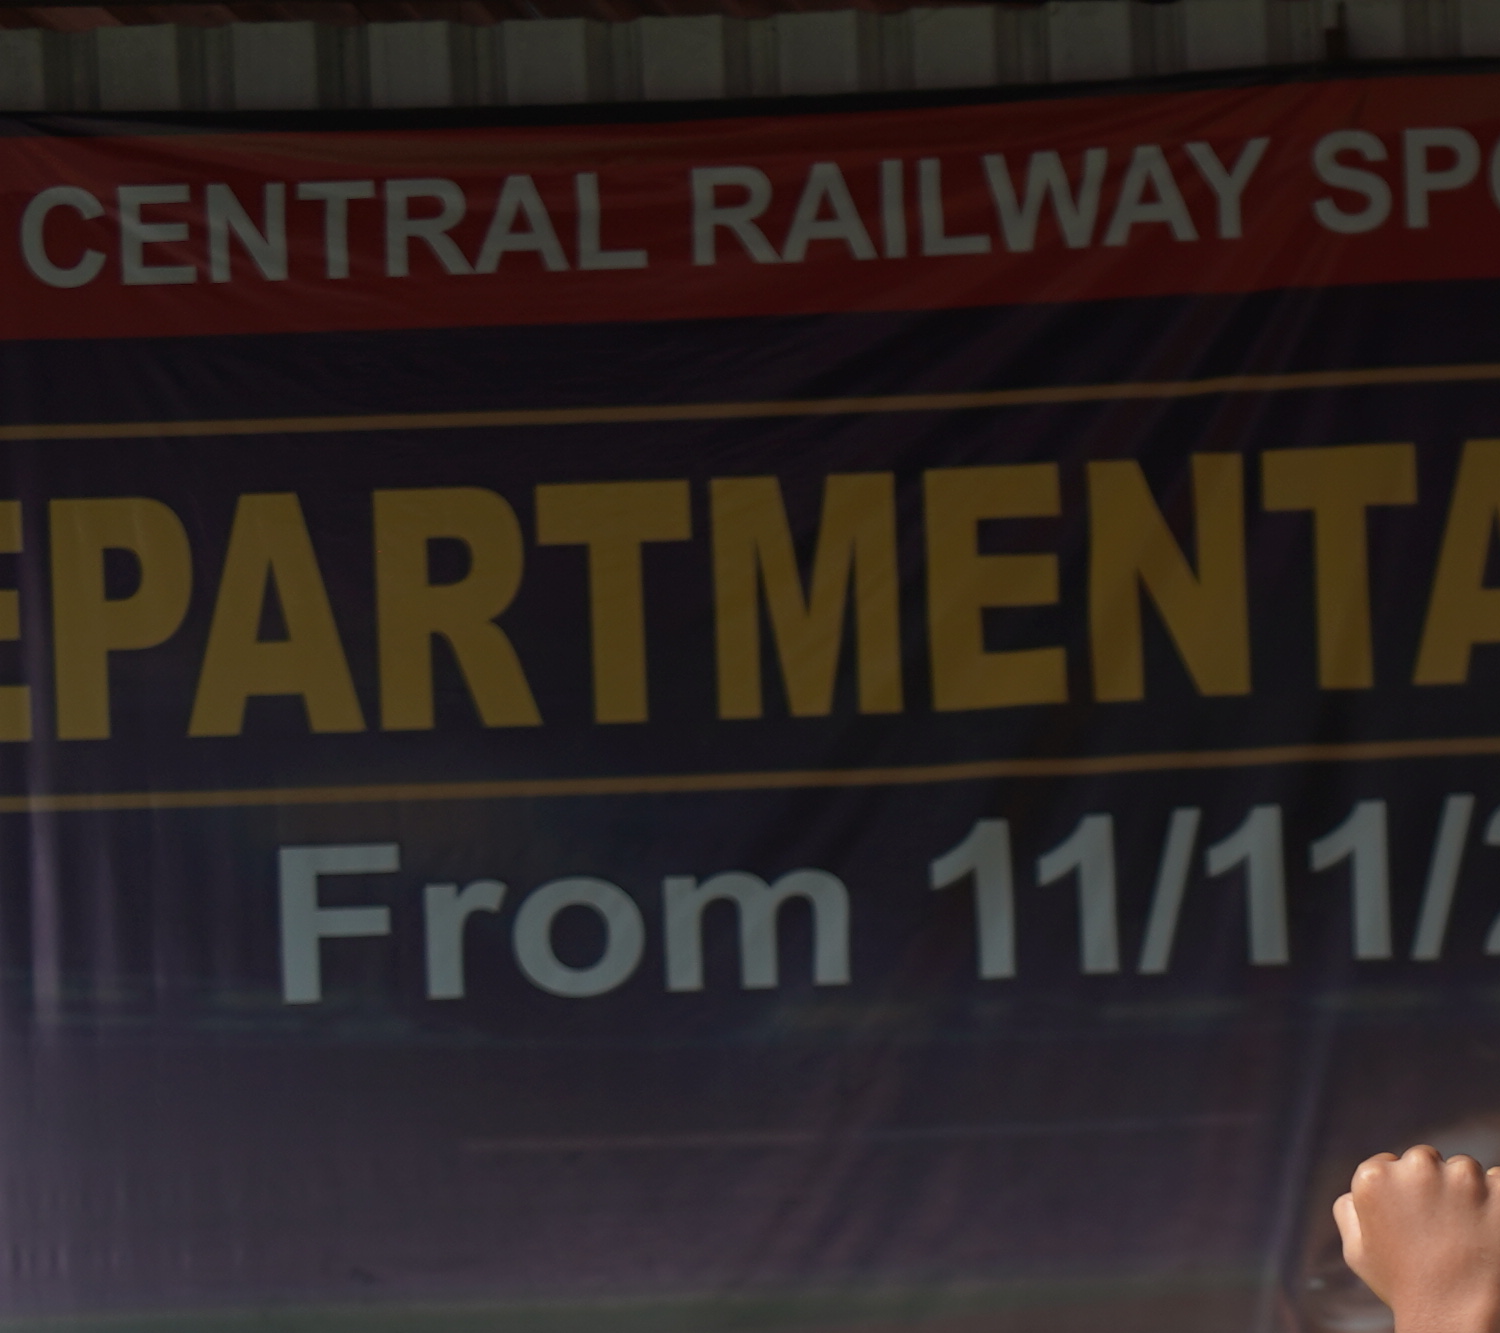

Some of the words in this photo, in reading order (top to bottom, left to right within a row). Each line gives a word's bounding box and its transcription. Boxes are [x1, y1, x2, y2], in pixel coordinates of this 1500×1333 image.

[19, 170, 648, 290] CENTRAL
[690, 137, 1273, 268] RAILWAY
[278, 842, 851, 1005] From
